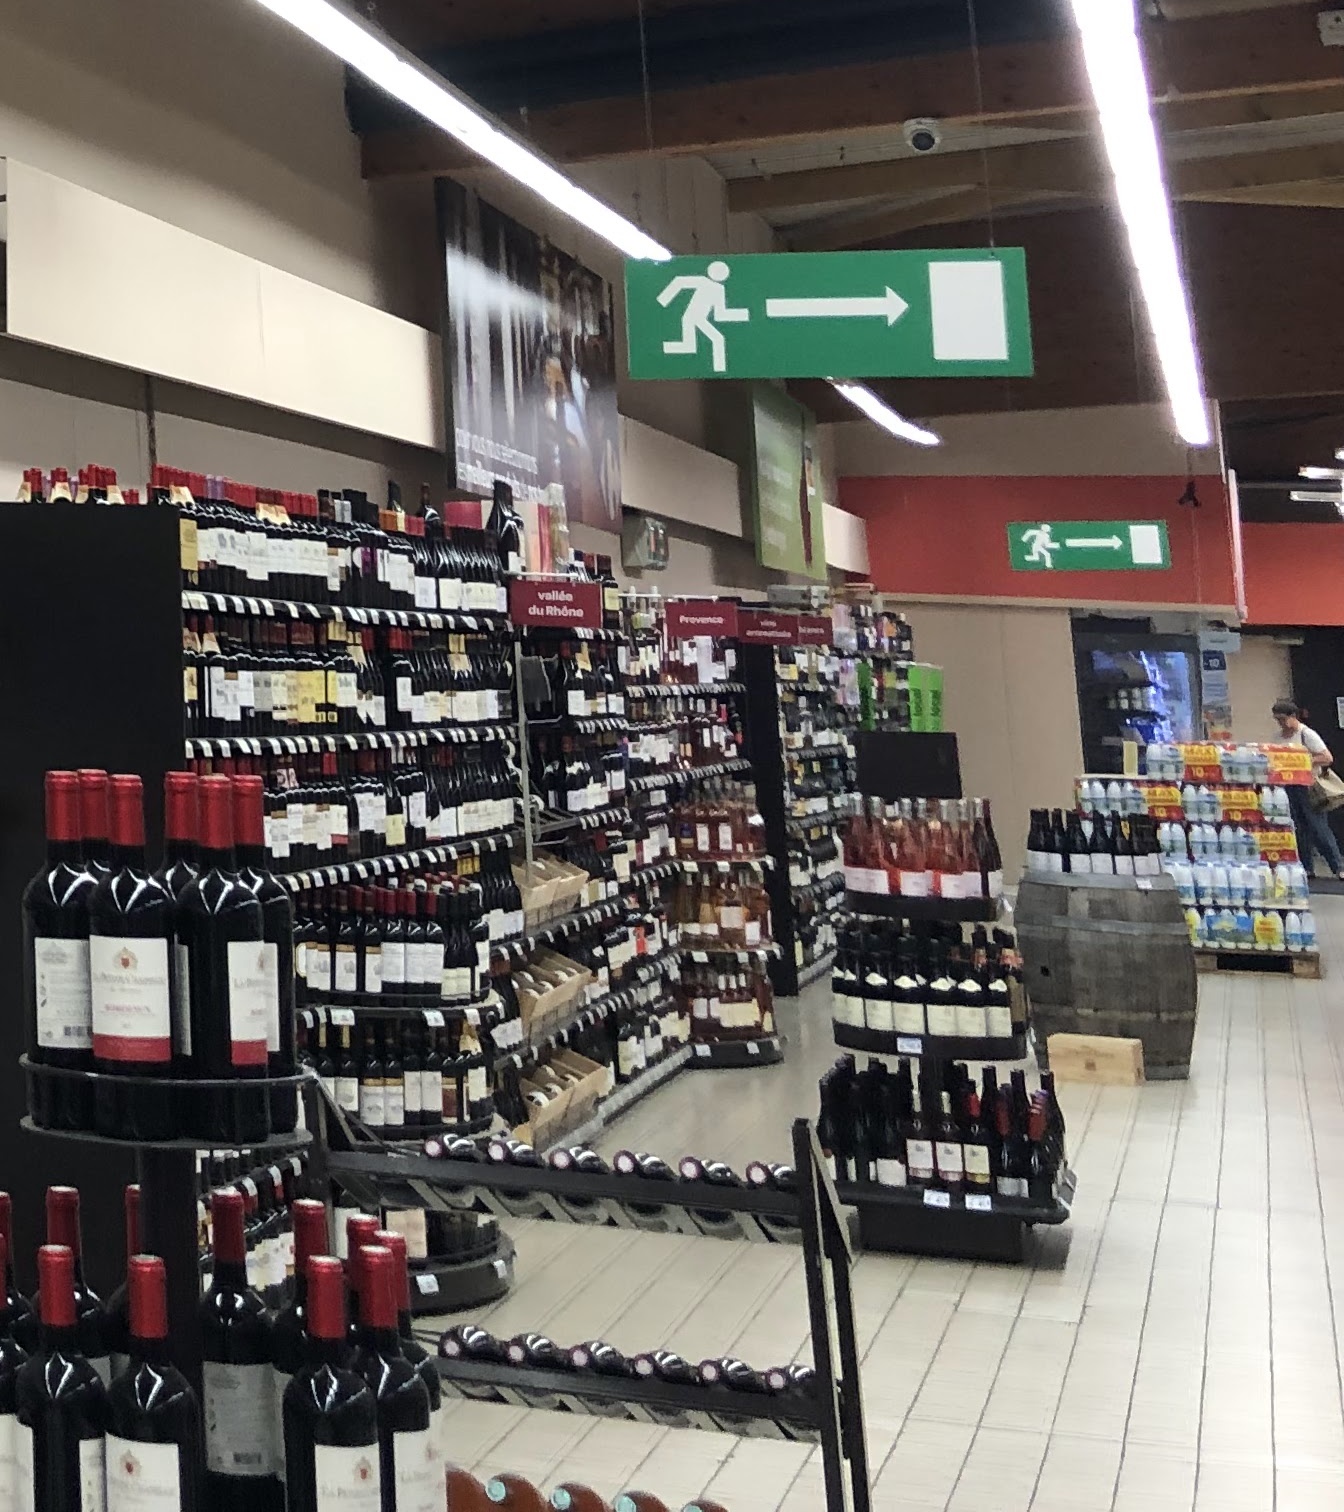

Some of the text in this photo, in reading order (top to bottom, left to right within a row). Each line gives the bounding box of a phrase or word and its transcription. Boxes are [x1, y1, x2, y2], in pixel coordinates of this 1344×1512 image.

[537, 590, 573, 602] vallée
[528, 605, 584, 618] du Rhône
[679, 614, 724, 625] Provence
